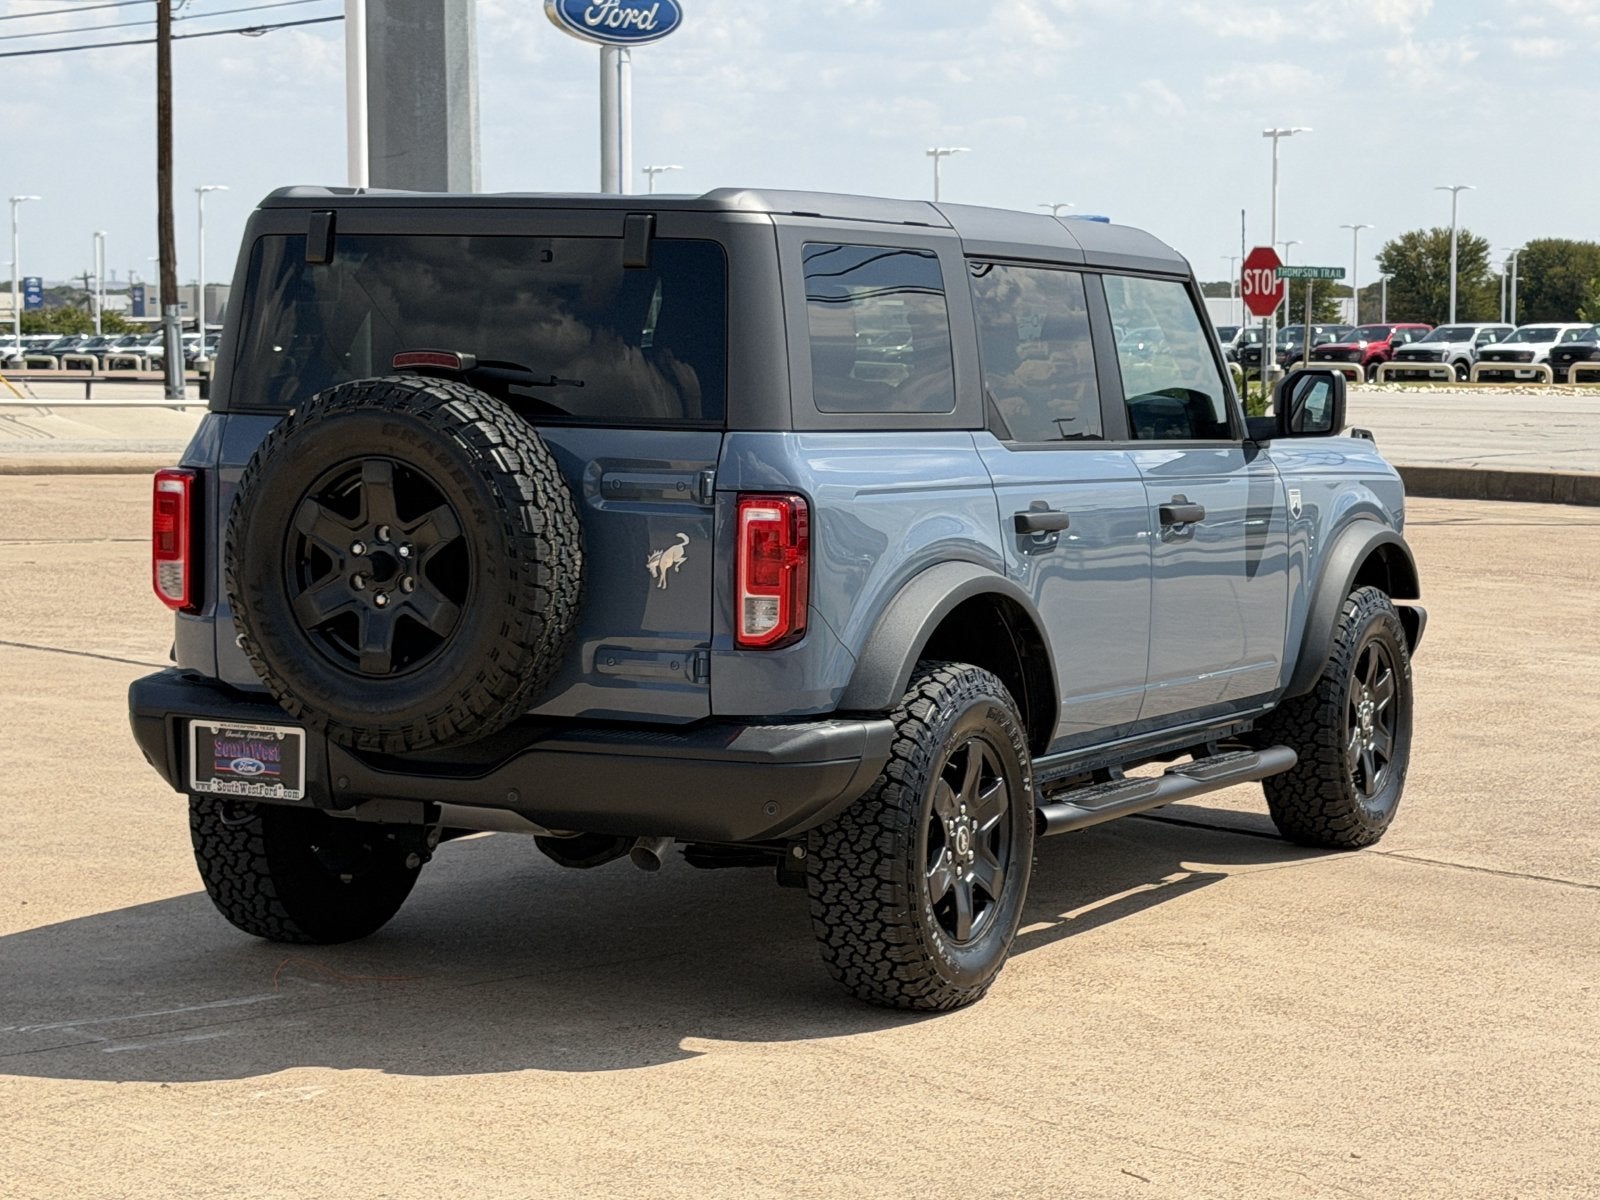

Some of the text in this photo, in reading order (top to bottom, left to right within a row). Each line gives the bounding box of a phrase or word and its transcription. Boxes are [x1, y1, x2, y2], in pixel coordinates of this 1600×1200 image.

[584, 0, 660, 30] Ford
[1277, 266, 1343, 278] THOMPSON TRAIL
[238, 761, 257, 772] Ford
